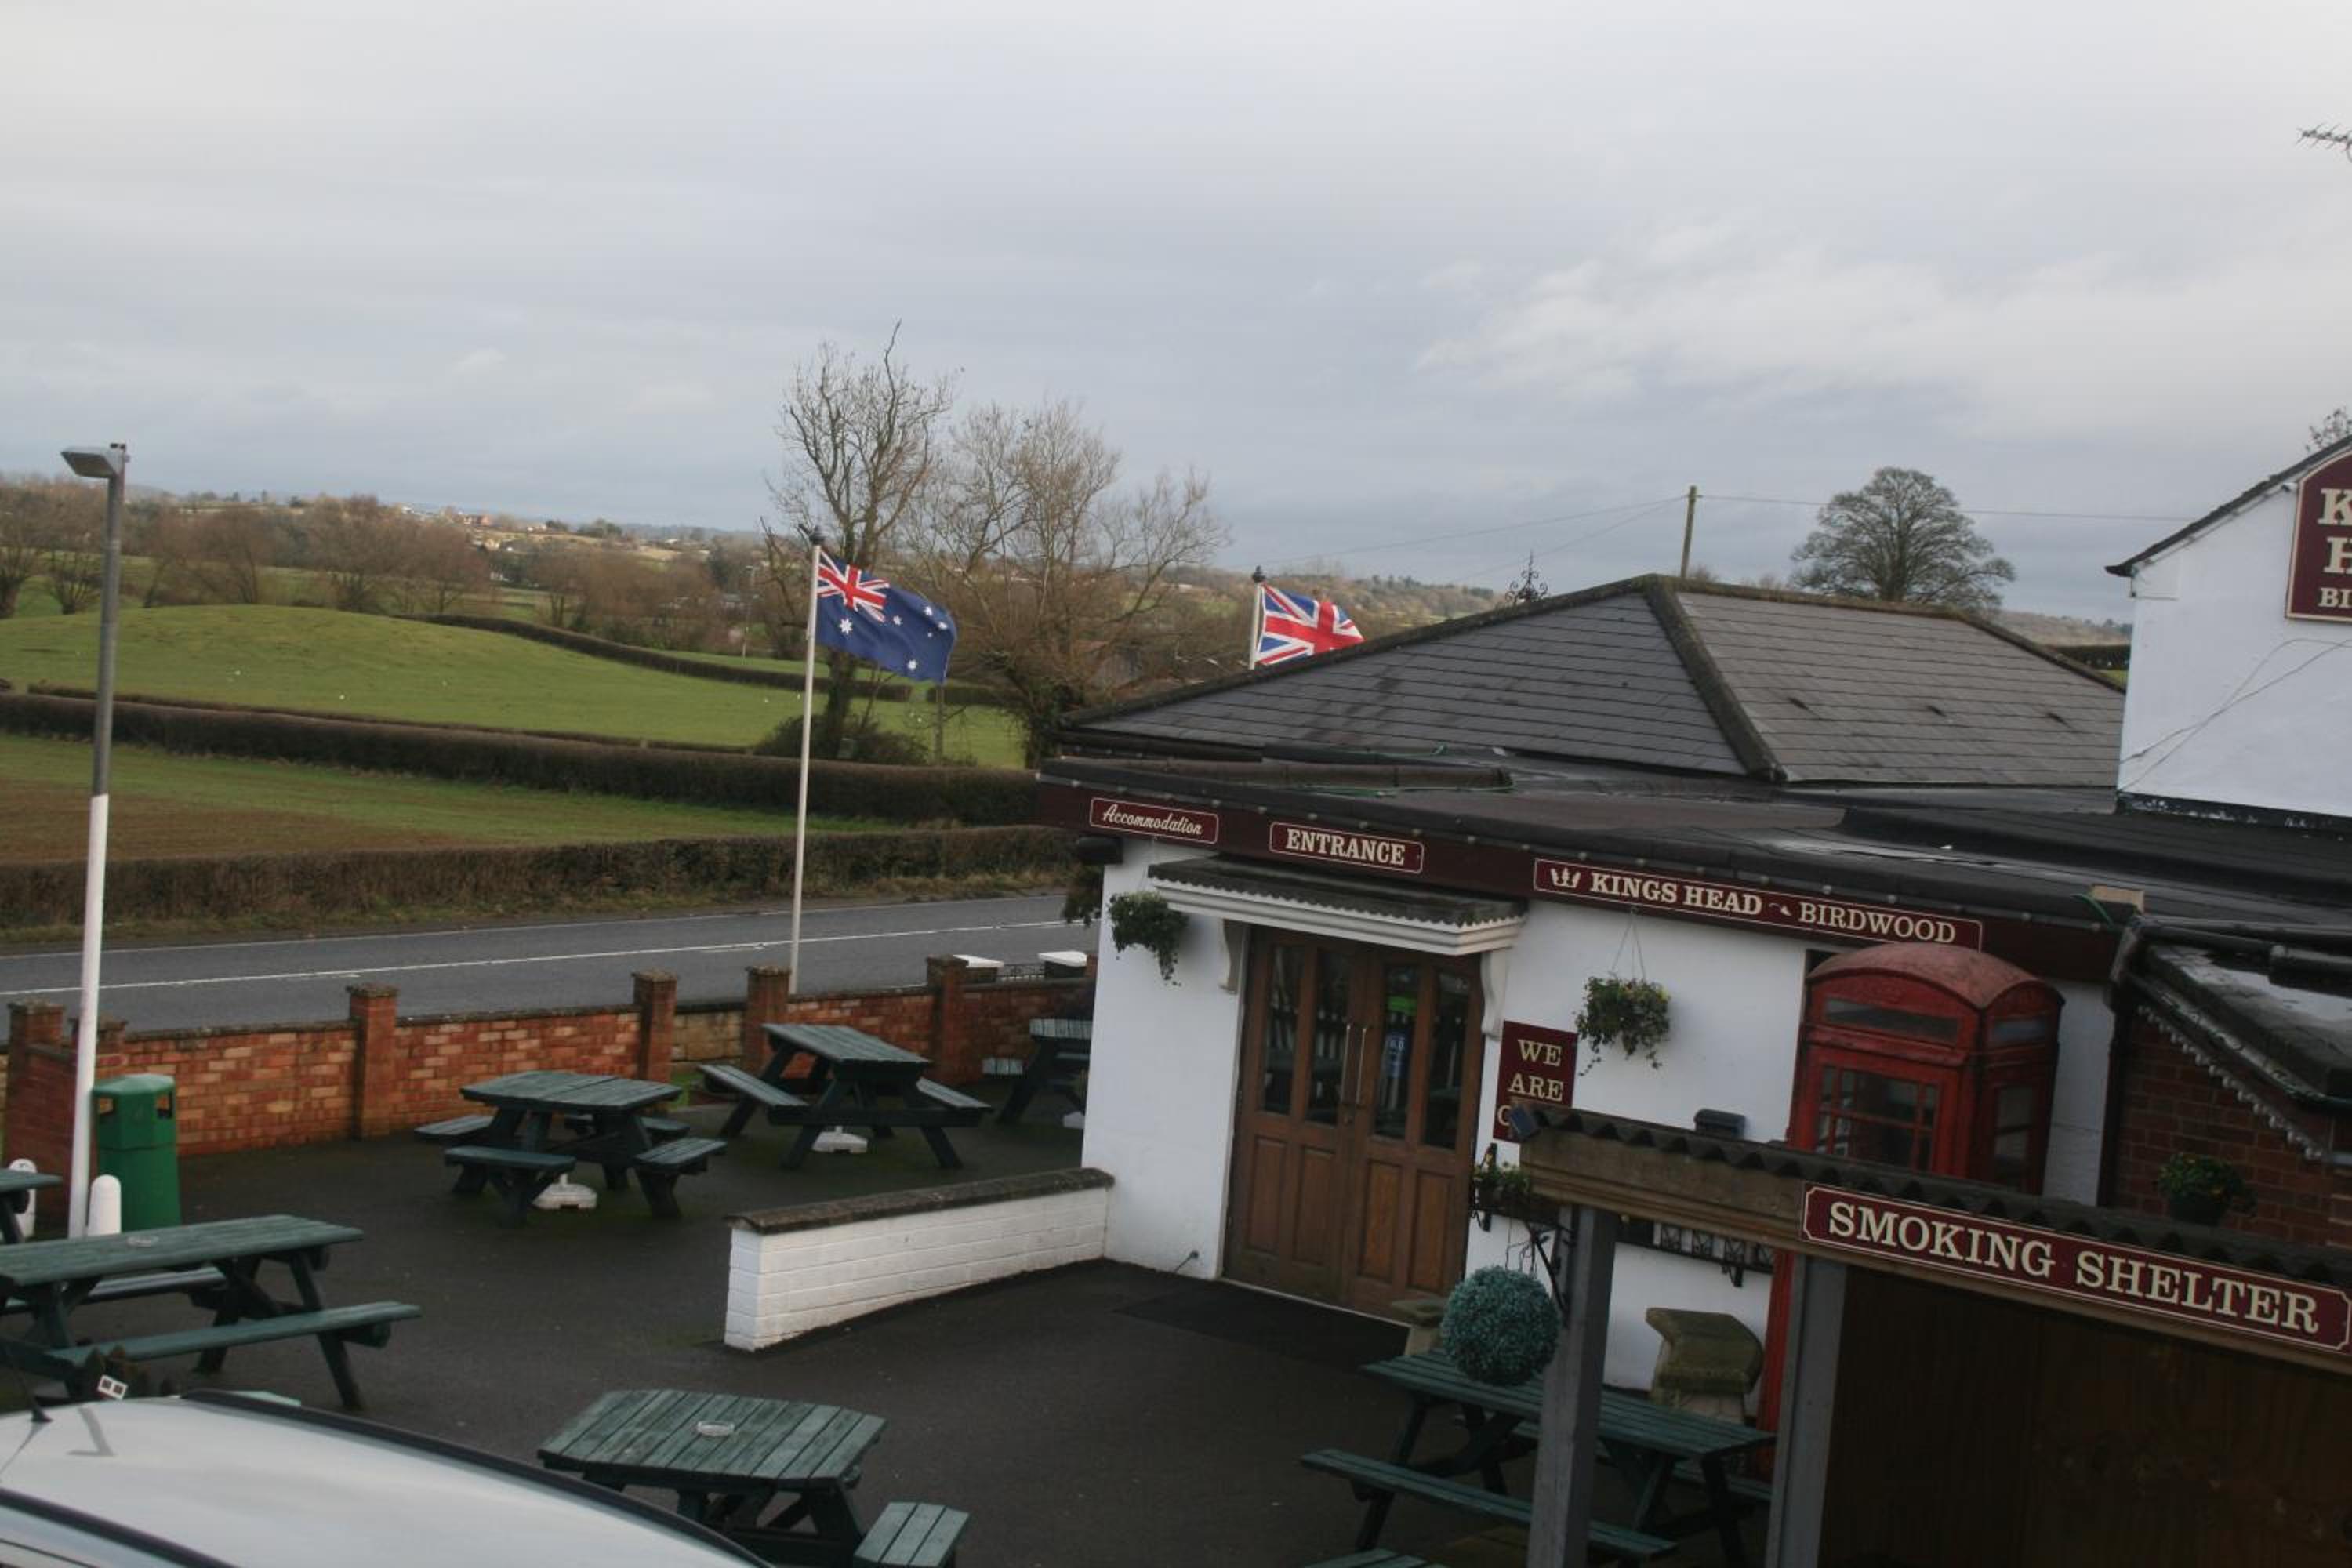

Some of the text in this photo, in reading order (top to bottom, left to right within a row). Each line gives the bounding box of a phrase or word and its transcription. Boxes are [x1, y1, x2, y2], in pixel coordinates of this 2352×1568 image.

[1103, 804, 1203, 836] Accommodation
[1285, 828, 1406, 865] ENTRANCE
[1590, 873, 1957, 943] KINGS HEAD BIRDWOOD
[1518, 1039, 1562, 1066] WE
[1508, 1073, 1564, 1102] ARE
[1828, 1202, 2319, 1334] SMOKING SHELTER
